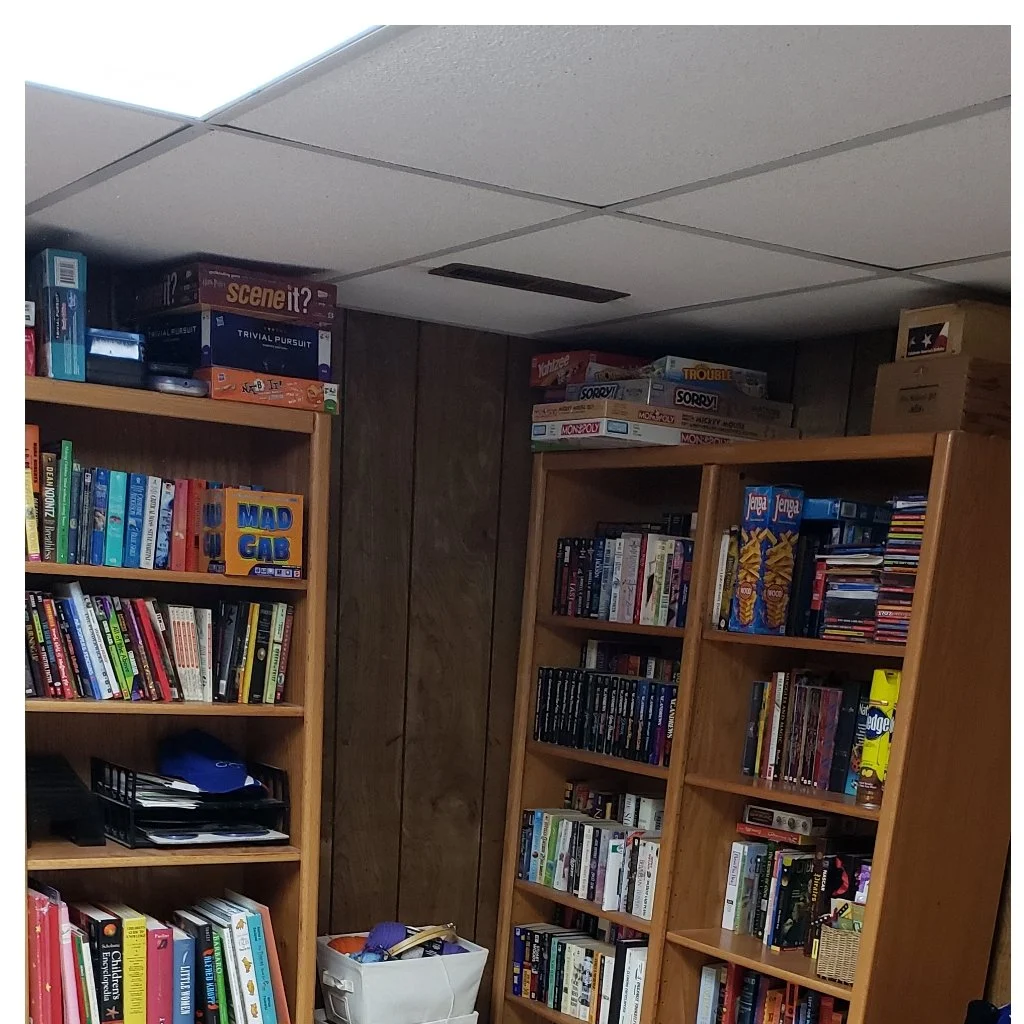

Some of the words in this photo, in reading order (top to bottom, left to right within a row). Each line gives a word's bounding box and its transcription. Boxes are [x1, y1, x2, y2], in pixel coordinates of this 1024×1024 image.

[236, 329, 273, 343] TRIVIAL
[274, 335, 312, 349] PURSUIT
[537, 353, 571, 379] Yahtzee
[682, 366, 733, 381] TROUBLE
[580, 384, 619, 400] SORRY!
[675, 387, 719, 411] SORRY!
[561, 423, 601, 436] MONOPOLY
[638, 409, 676, 424] MONOPOLY
[45, 466, 54, 487] DEAN
[44, 487, 55, 518] KOONTZ
[745, 493, 768, 520] Jenga
[772, 494, 800, 521] Jenga
[237, 502, 293, 532] MAD
[44, 525, 55, 560] Breathless
[238, 533, 291, 561] GAB
[820, 869, 829, 892] NASCAR
[100, 951, 111, 1002] Encyclopedia
[110, 949, 123, 1001] Children's
[180, 965, 190, 988] LITTLE
[203, 955, 214, 983] ALFRED
[180, 988, 191, 1016] WOMEN
